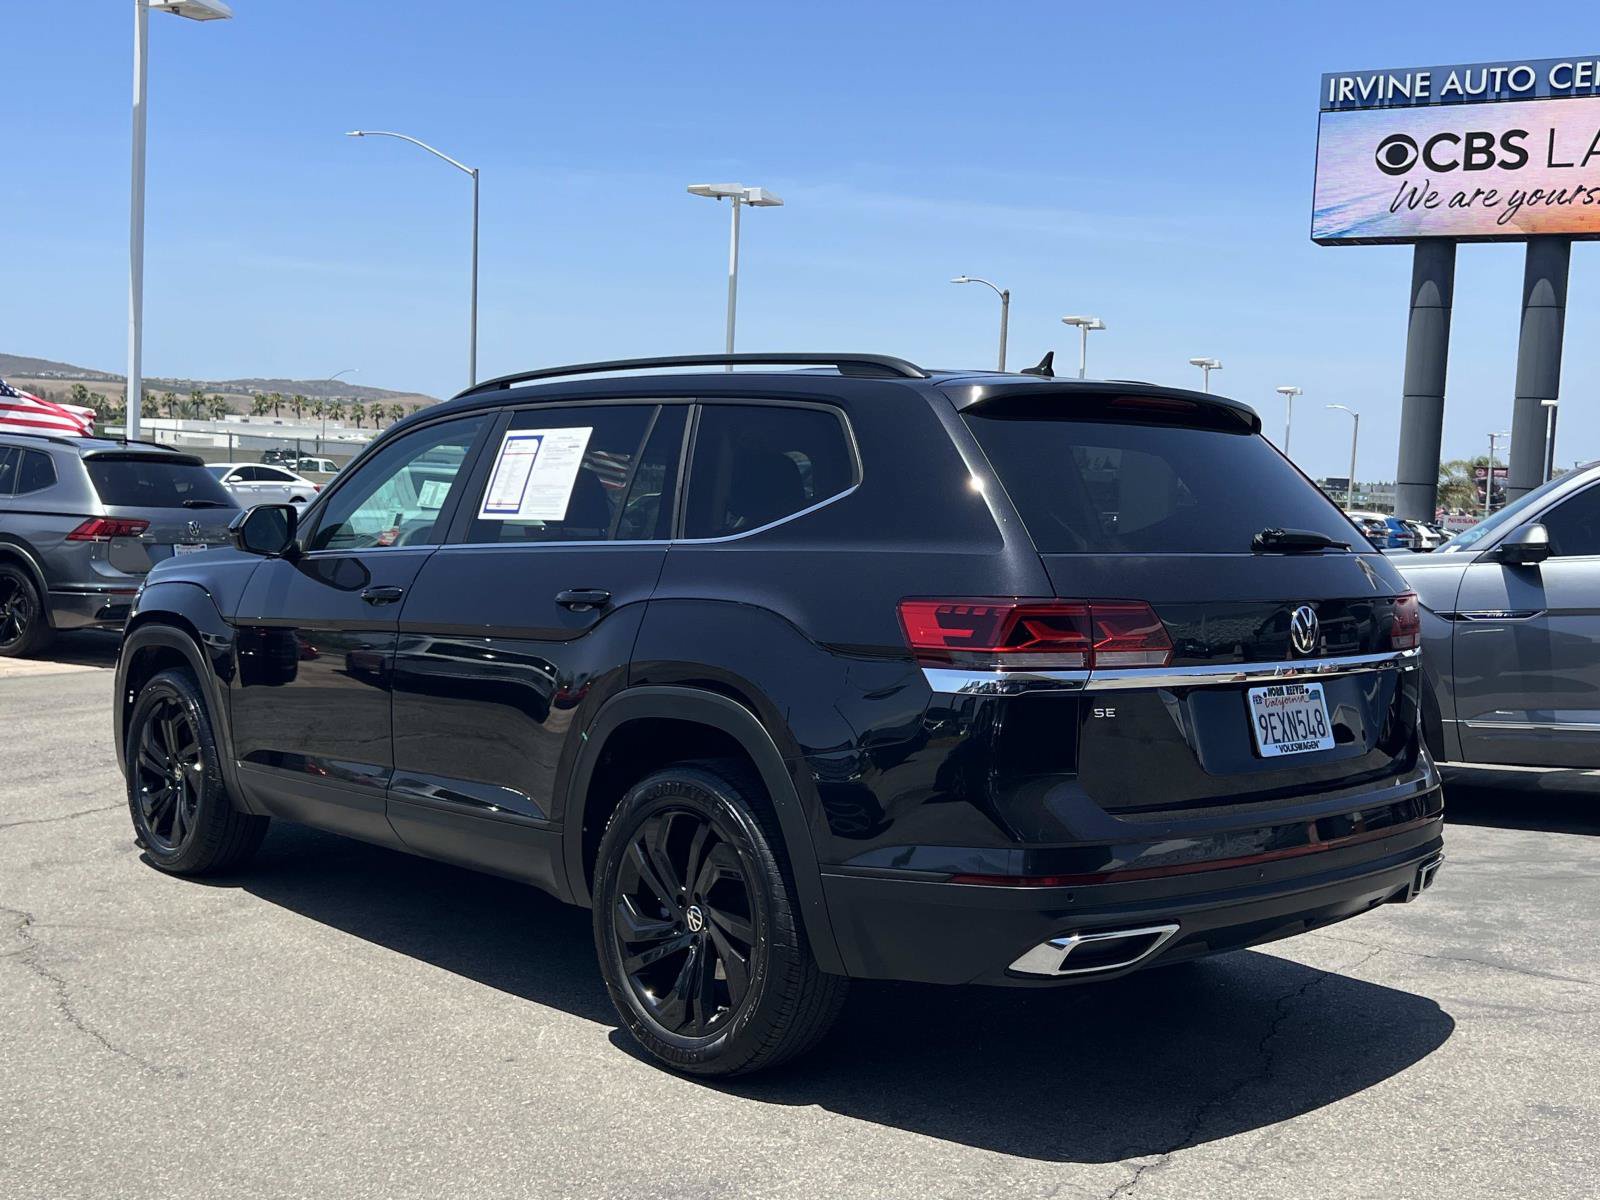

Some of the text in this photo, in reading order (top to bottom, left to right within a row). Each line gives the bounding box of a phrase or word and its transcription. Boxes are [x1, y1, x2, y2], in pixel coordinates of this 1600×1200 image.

[1329, 61, 1600, 102] IRVINE AUTO CE
[1422, 129, 1530, 173] CBS
[1390, 179, 1445, 213] We
[1449, 186, 1504, 209] are
[1094, 708, 1116, 718] SE
[1264, 694, 1310, 710] California
[1259, 708, 1326, 745] 9EXN548
